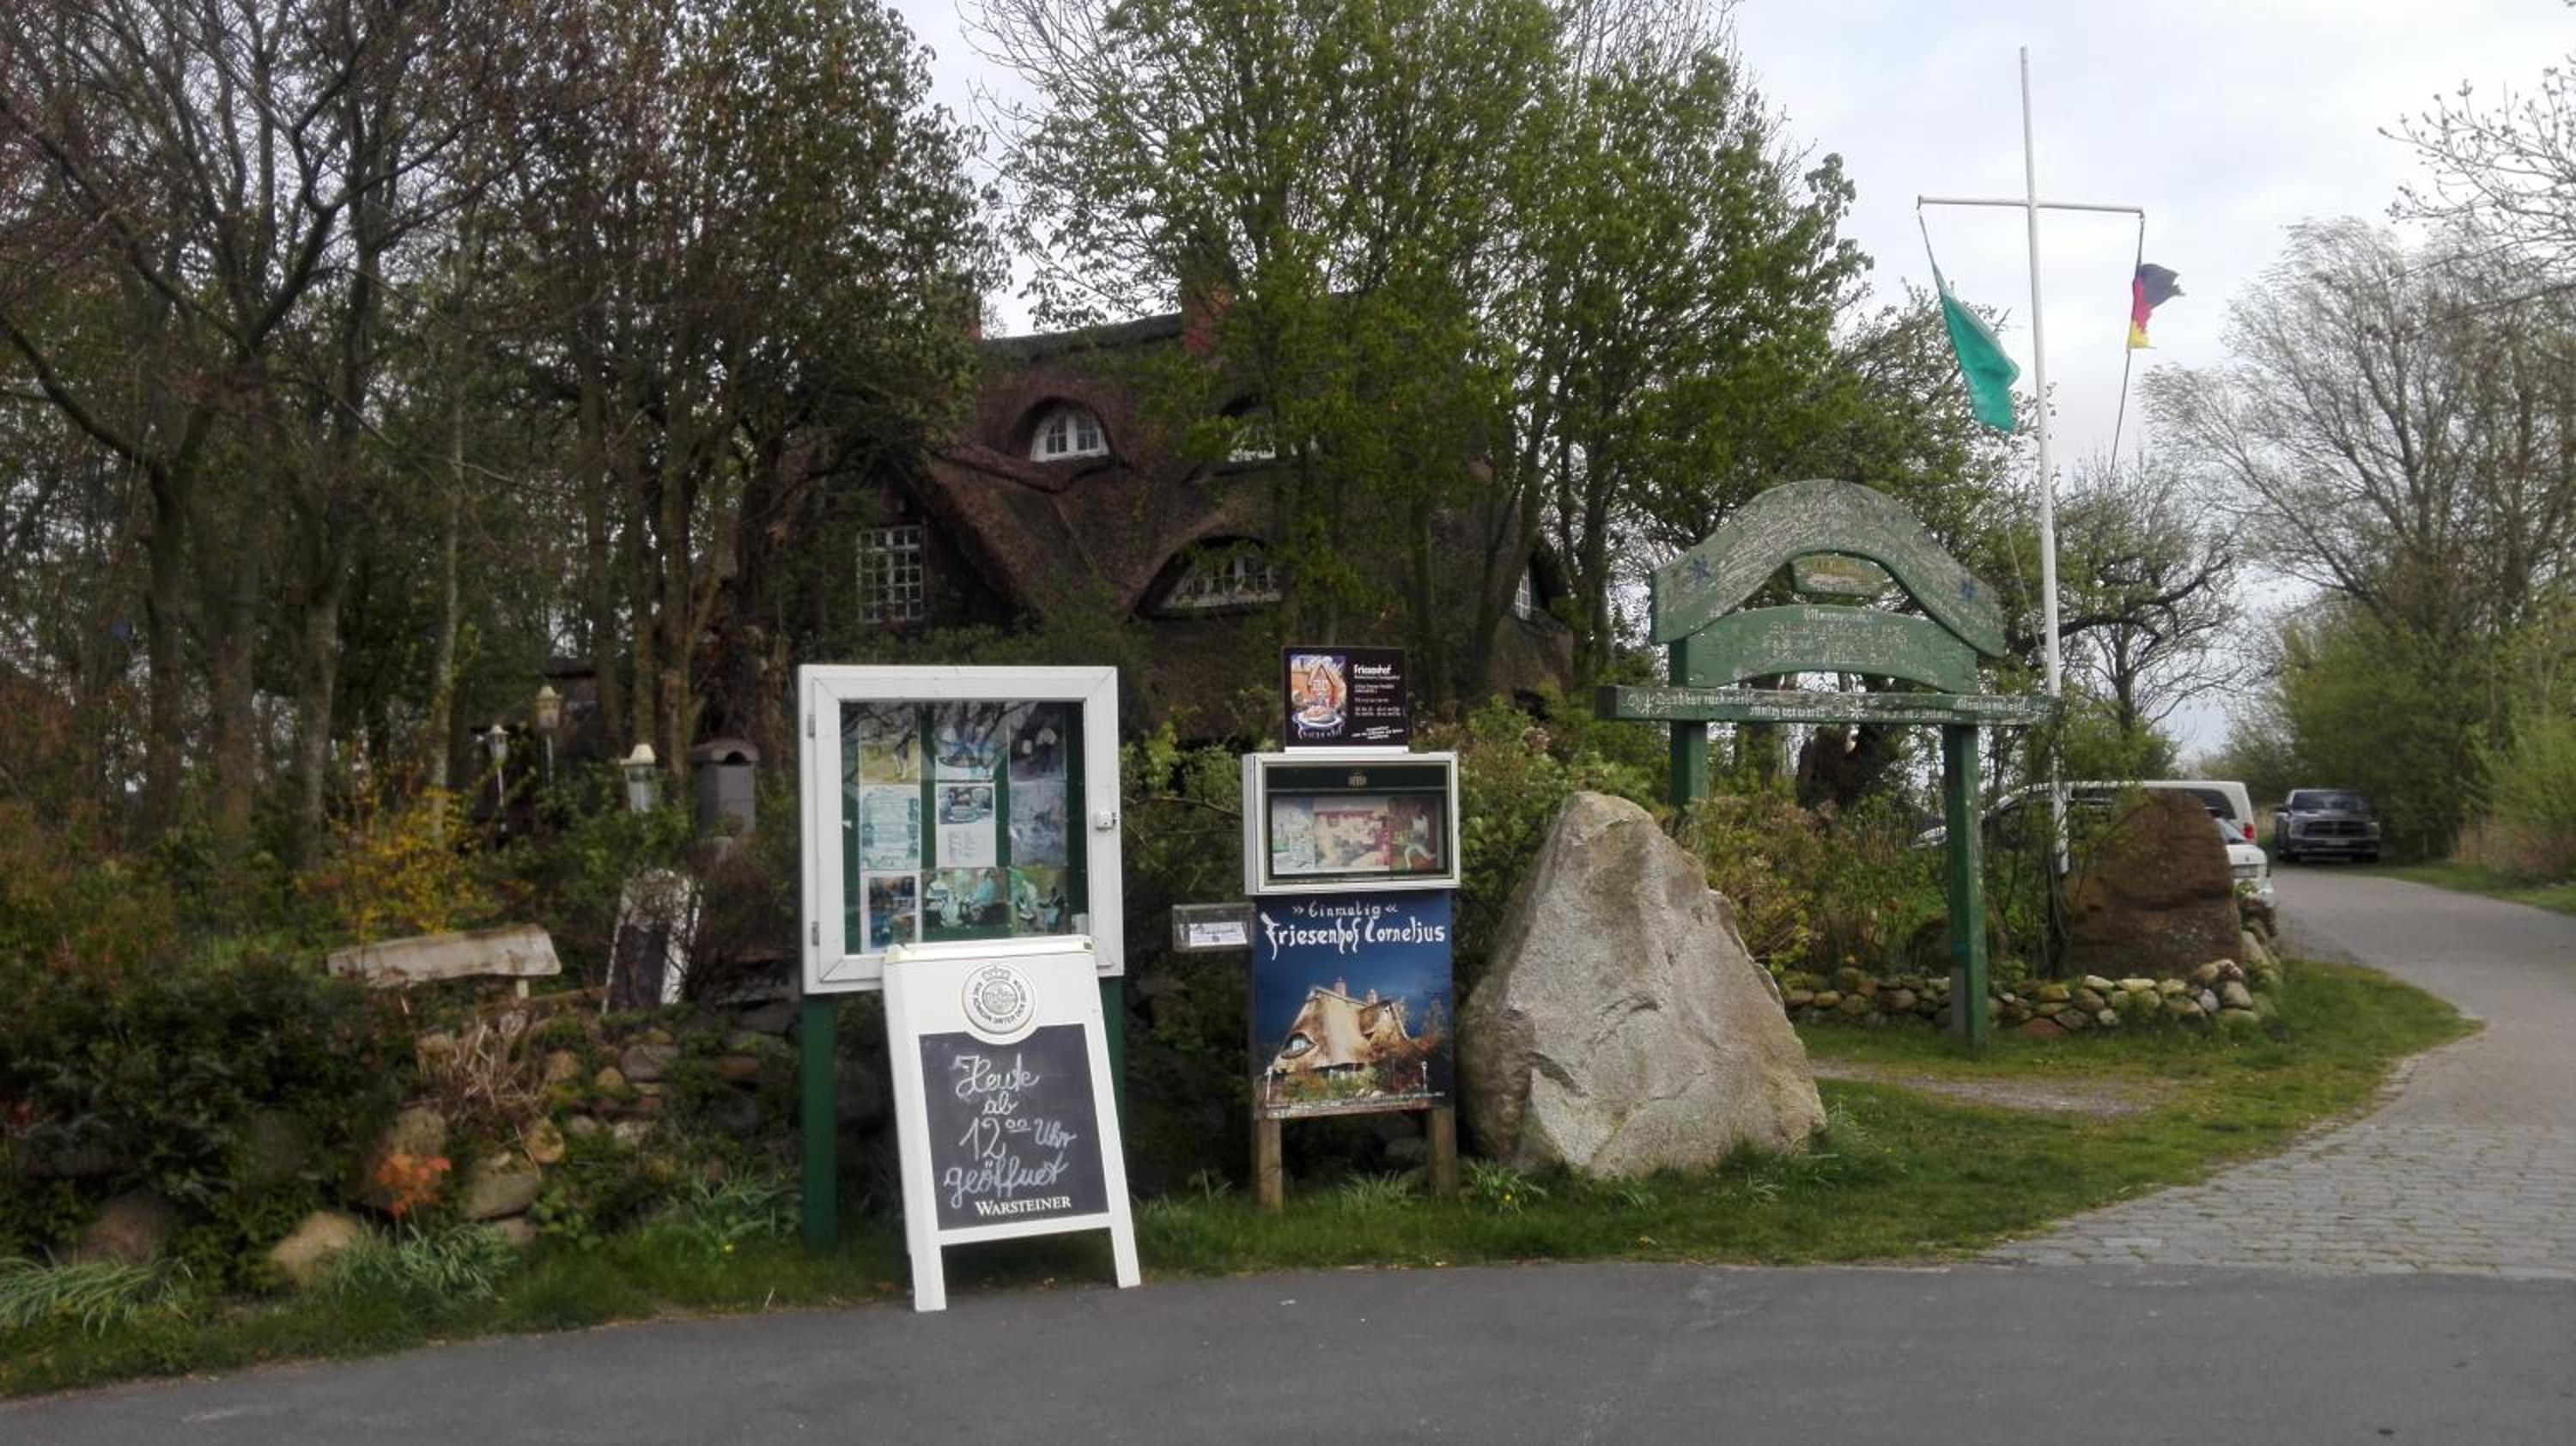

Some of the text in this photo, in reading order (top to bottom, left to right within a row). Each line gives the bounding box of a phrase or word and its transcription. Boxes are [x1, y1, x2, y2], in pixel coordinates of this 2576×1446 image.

[951, 1053, 1041, 1100] Heute
[981, 1090, 1018, 1115] ab
[1033, 1117, 1077, 1148] Uhr
[945, 1151, 1069, 1209] geöffnet
